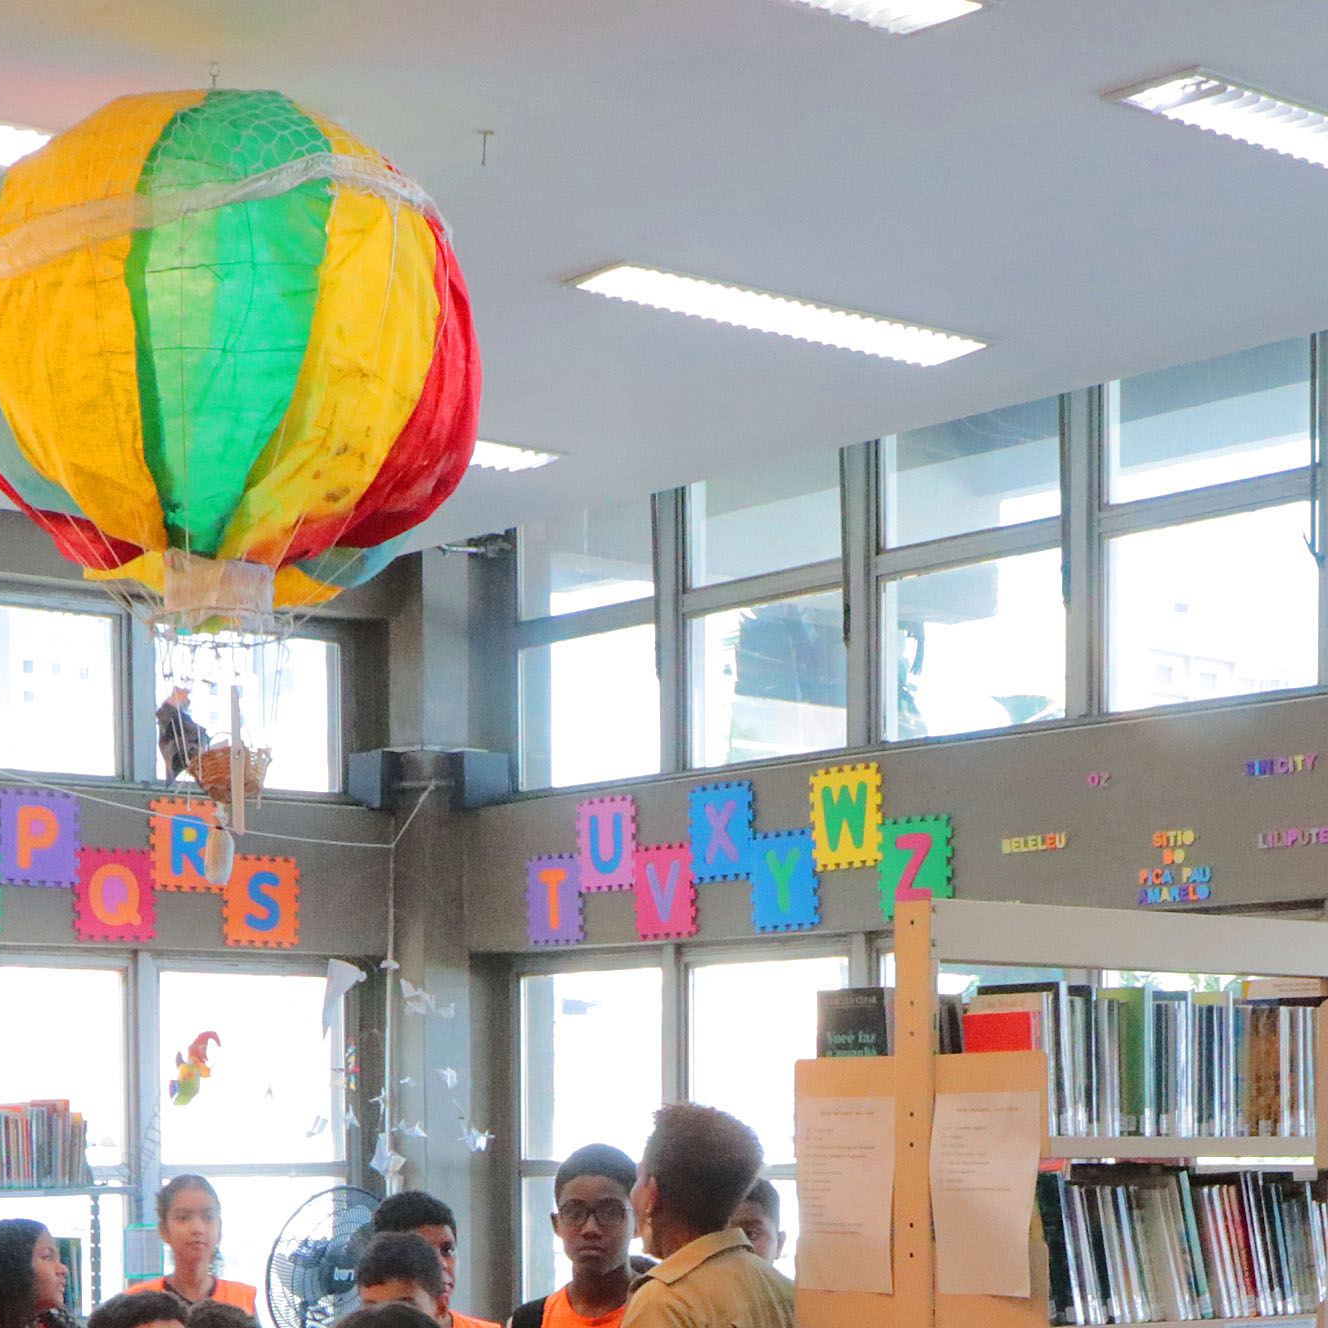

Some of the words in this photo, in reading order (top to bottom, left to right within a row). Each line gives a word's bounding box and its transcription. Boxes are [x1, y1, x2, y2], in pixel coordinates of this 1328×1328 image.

[1087, 772, 1112, 788] OZ
[539, 868, 567, 930] T
[589, 812, 623, 874] U
[646, 860, 681, 923] V
[704, 800, 739, 864] X
[765, 847, 800, 912] Y
[821, 781, 868, 853] W
[895, 833, 932, 901] Z
[1162, 848, 1186, 865] DO
[16, 806, 59, 869] P
[88, 864, 143, 926] Q
[170, 815, 212, 876] R
[245, 872, 282, 932] S
[1137, 868, 1173, 886] PICA
[1181, 866, 1212, 885] PAU
[1137, 884, 1212, 905] AMARELO
